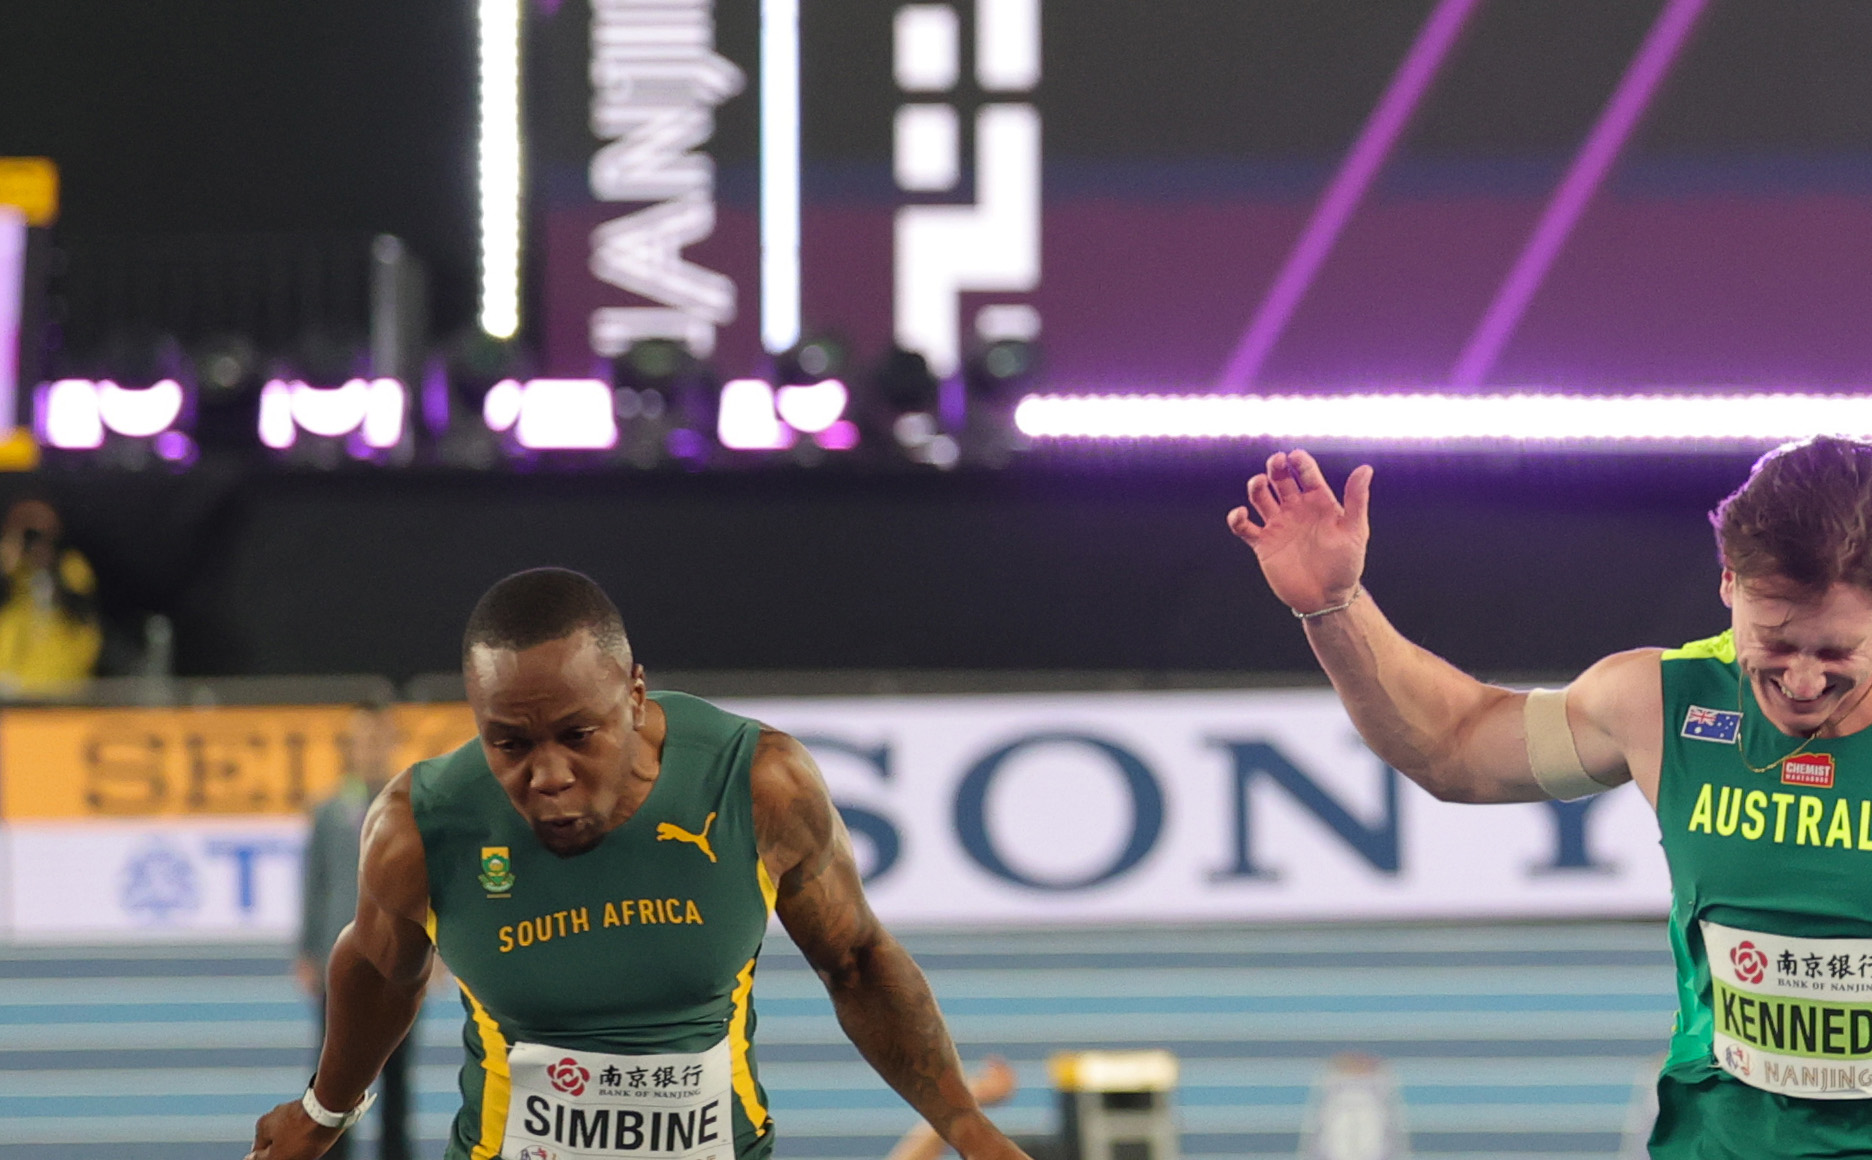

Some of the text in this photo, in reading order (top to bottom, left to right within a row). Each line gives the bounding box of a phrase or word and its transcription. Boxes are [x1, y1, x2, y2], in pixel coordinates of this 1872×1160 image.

[1785, 761, 1831, 777] CHEMIST
[499, 898, 705, 953] SOUTH AFRICA
[1777, 978, 1809, 990] BANK
[1812, 982, 1826, 991] OF
[598, 1064, 704, 1089] 南京银行
[598, 1087, 702, 1099] BANK OF NANJING
[524, 1094, 720, 1152] SIMBINE
